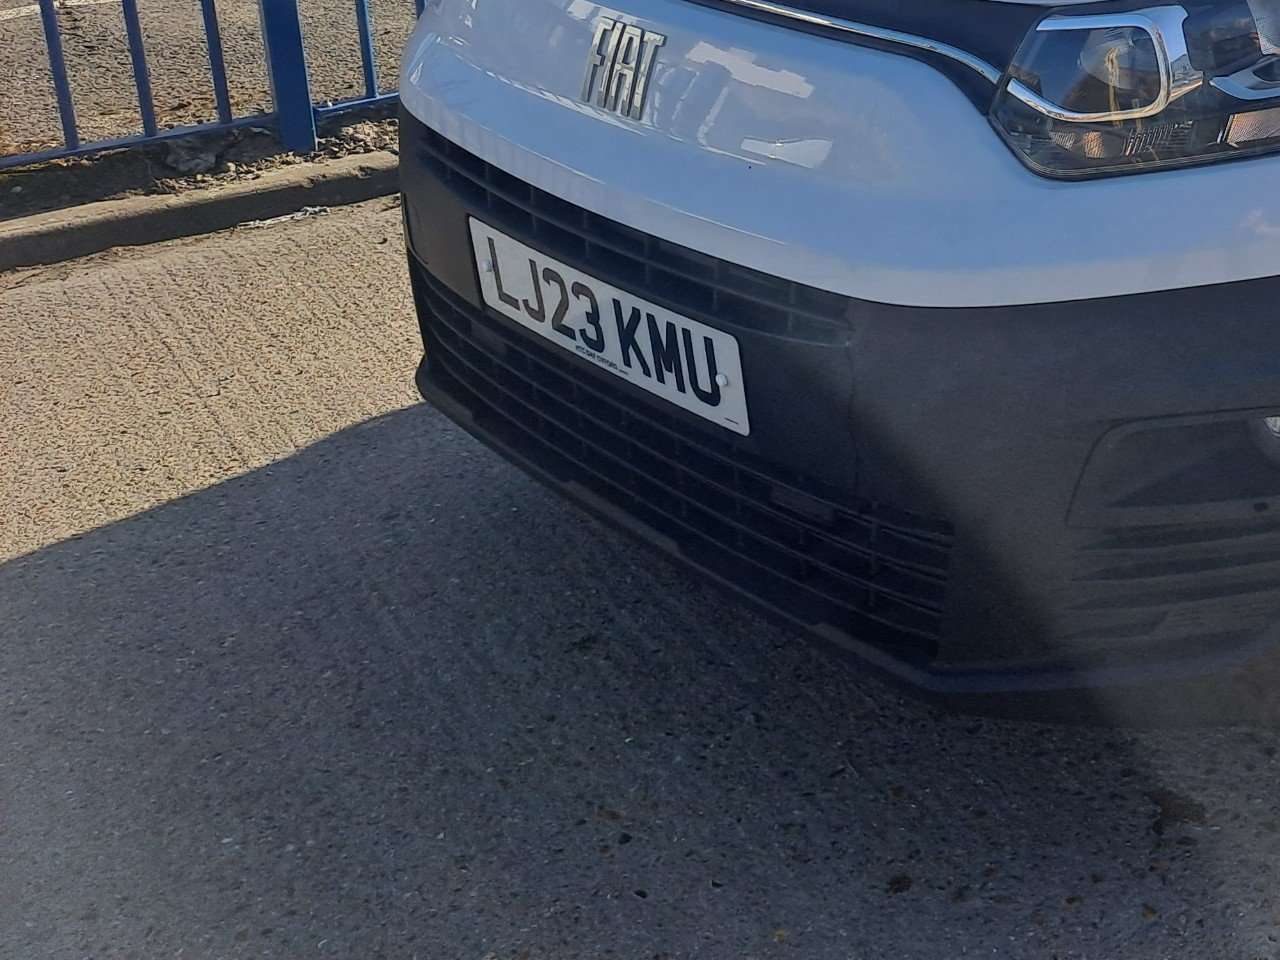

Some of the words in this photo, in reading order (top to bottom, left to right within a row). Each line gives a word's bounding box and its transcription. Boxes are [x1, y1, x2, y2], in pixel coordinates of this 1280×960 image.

[580, 16, 667, 121] FIAT
[487, 236, 606, 354] LJ23
[612, 297, 721, 408] KMU
